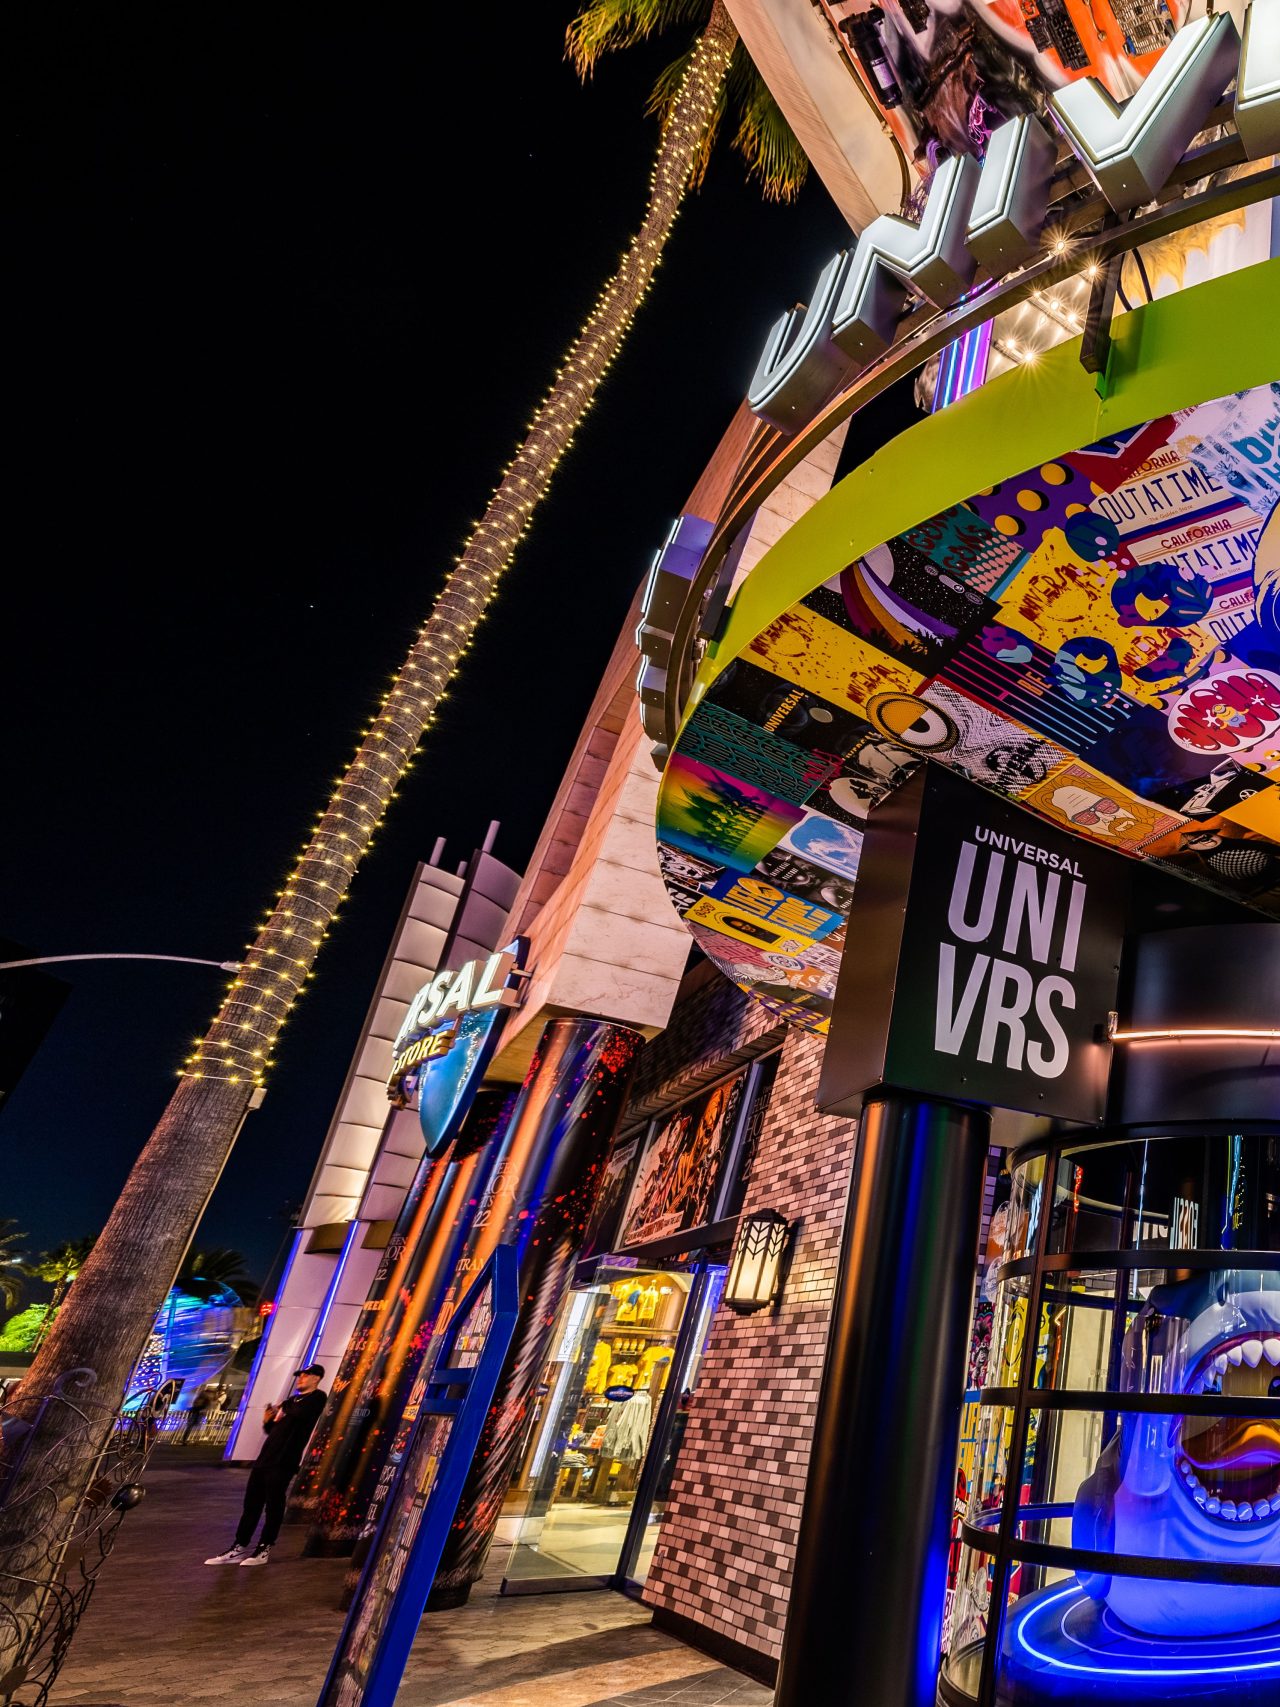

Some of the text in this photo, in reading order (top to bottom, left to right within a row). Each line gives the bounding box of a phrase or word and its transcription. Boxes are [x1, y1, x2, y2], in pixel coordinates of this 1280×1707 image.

[1098, 467, 1223, 526] OUTATIME
[1160, 519, 1232, 549] CALIFORNIA
[763, 689, 805, 733] UNIVERSAL
[974, 825, 1084, 878] UNIVERSAL
[948, 840, 1087, 973] UNI
[934, 941, 1076, 1079] VRS
